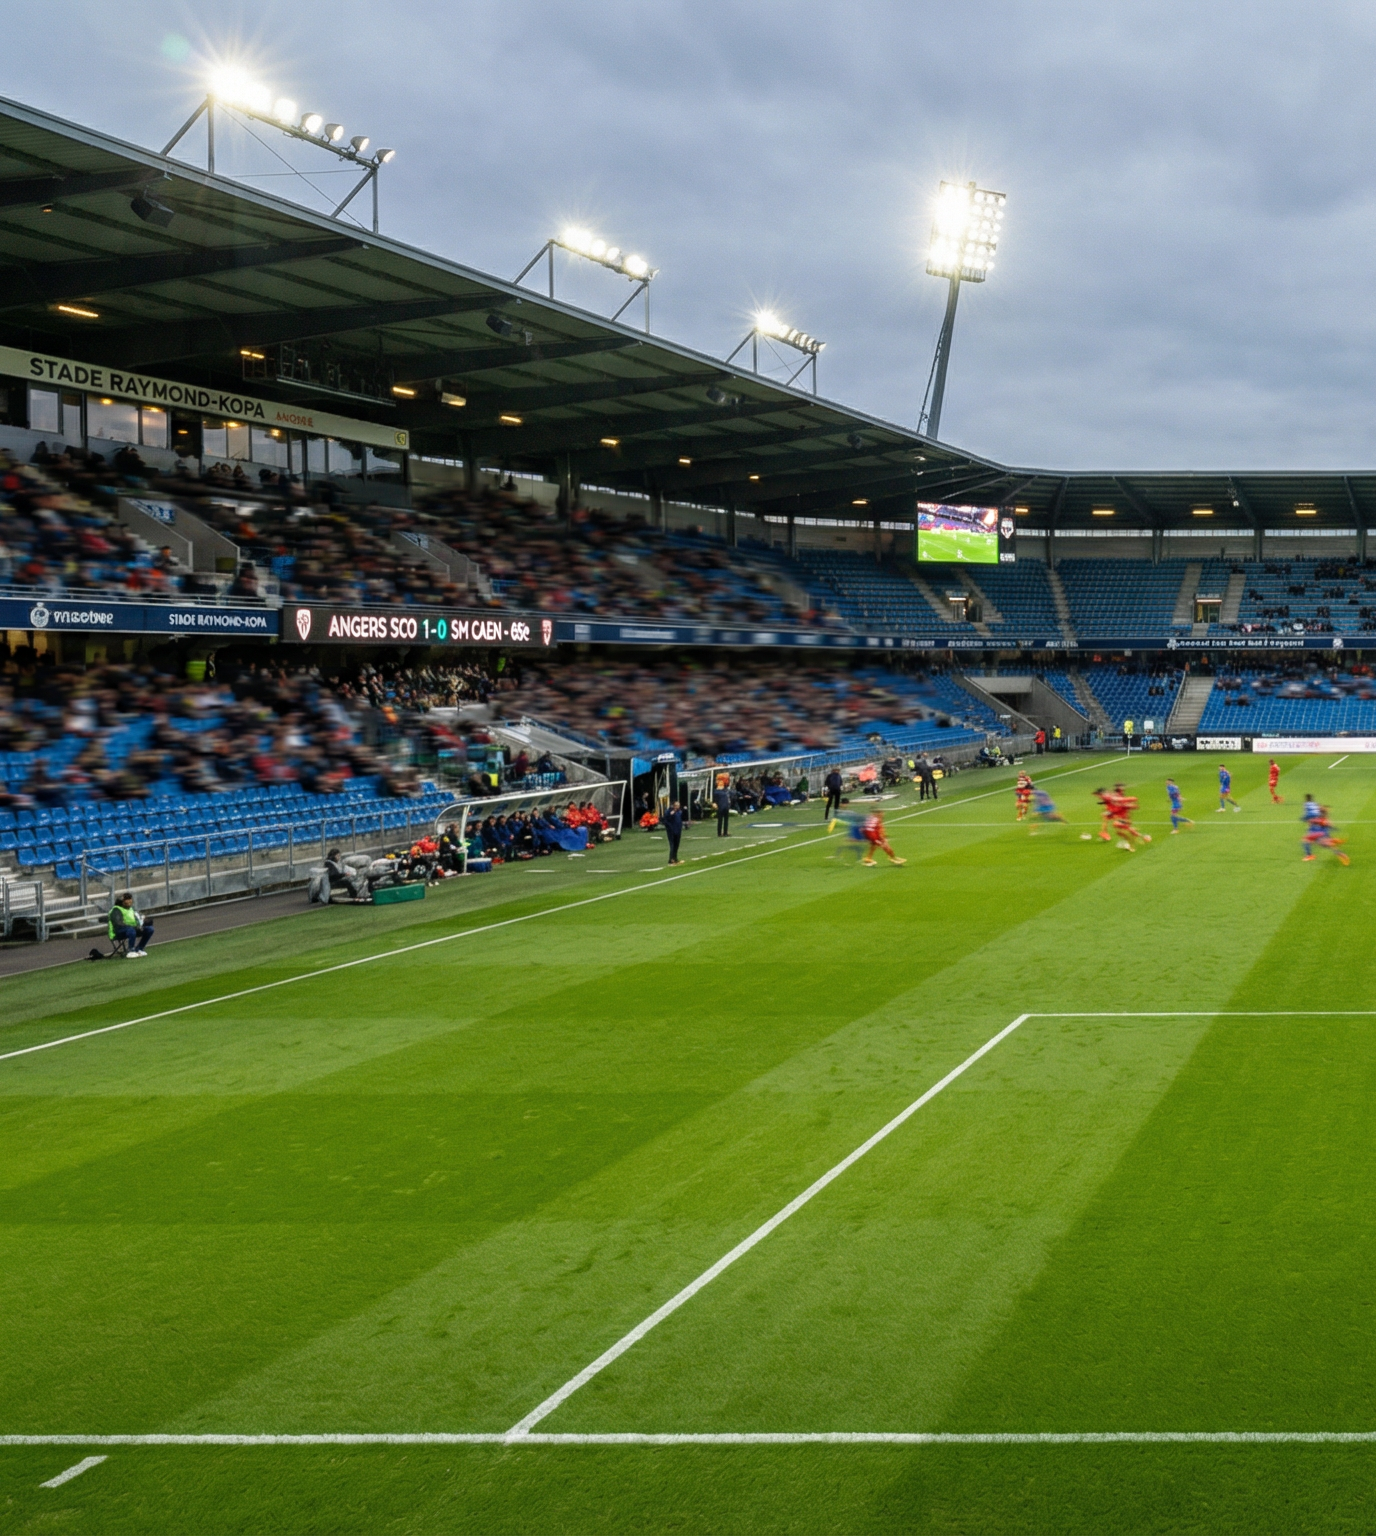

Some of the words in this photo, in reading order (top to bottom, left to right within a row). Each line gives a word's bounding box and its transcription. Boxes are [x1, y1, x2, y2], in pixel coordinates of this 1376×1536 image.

[30, 357, 103, 388] STADE
[110, 373, 265, 419] RAYMOND-KOPA
[328, 614, 388, 639] ANGERS
[390, 617, 418, 639] SCO
[422, 618, 447, 640] 1-0
[450, 619, 469, 640] SM
[471, 620, 502, 640] CAEN
